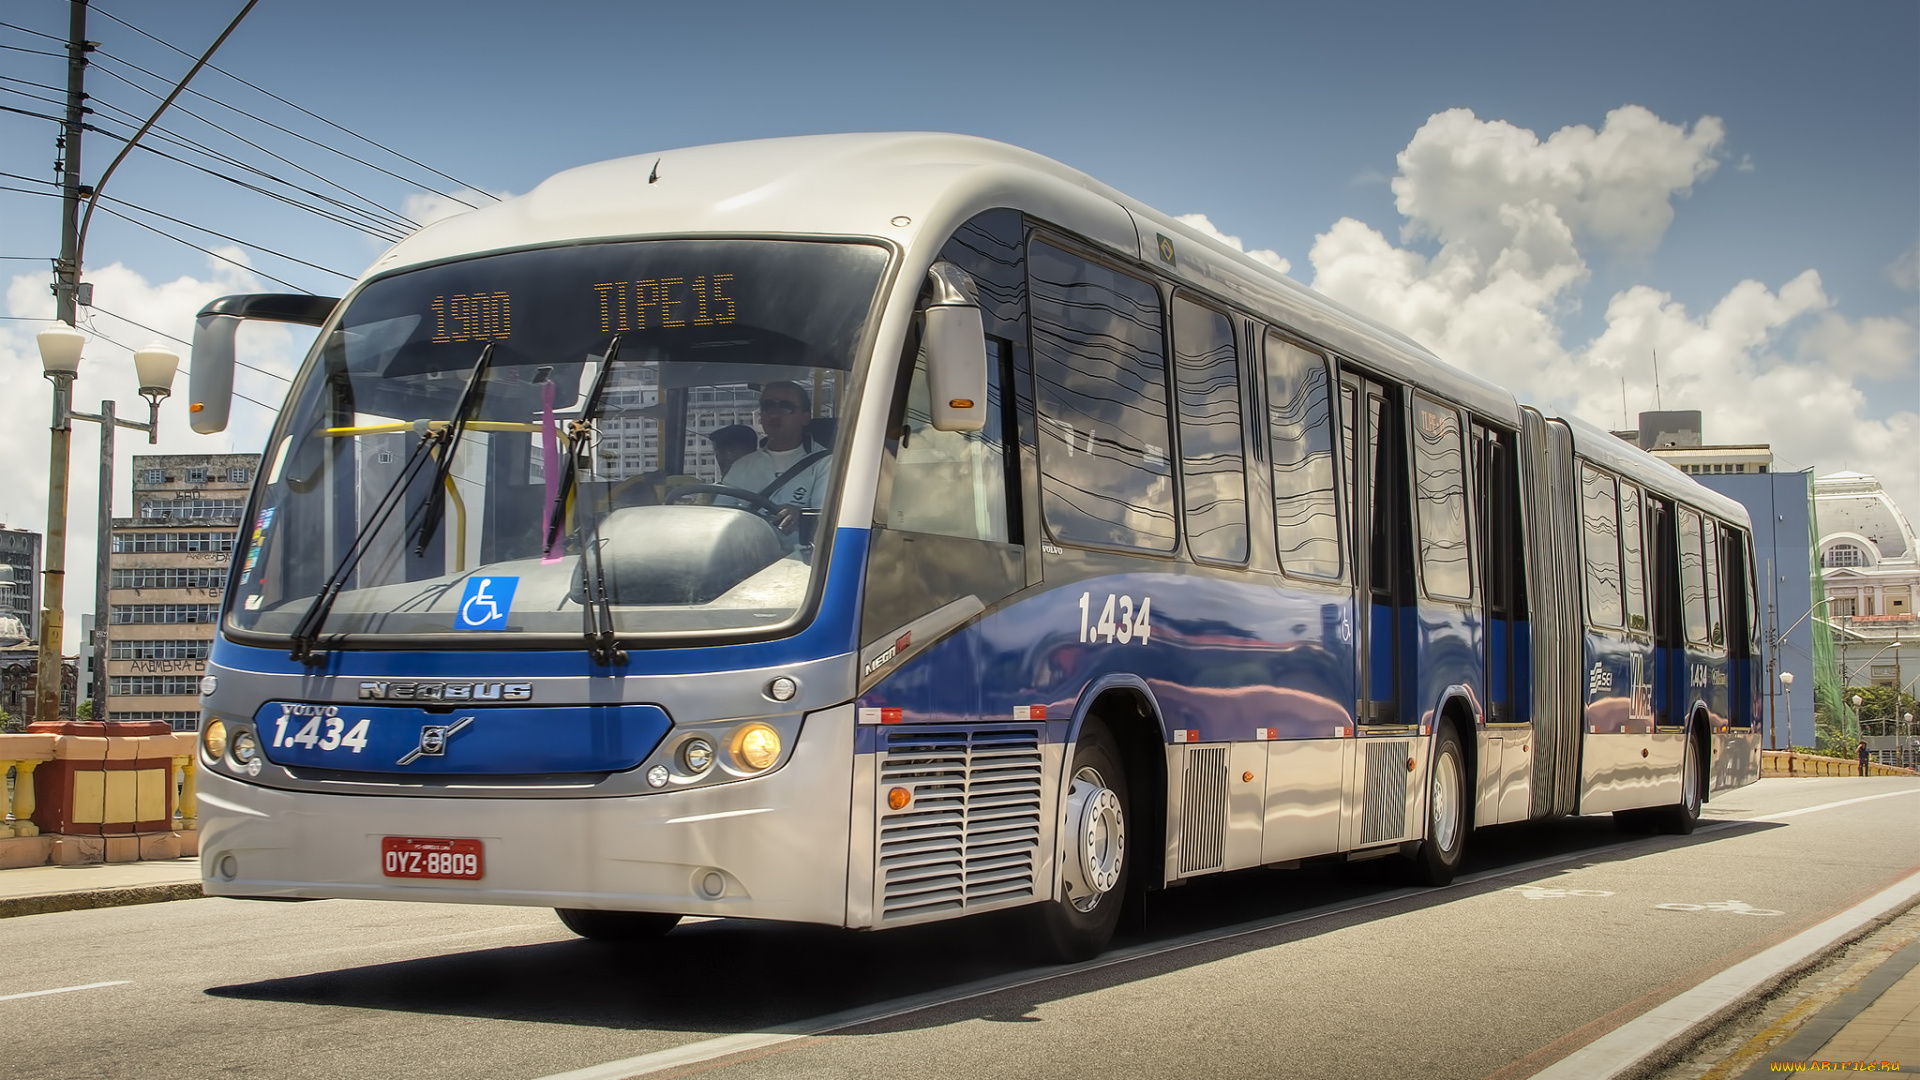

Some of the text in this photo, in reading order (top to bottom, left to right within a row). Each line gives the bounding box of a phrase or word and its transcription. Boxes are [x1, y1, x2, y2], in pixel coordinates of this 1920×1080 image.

[692, 273, 736, 327] 15
[431, 291, 511, 343] 1900
[1042, 545, 1063, 555] VOLVO
[1079, 591, 1151, 645] 1.434
[358, 681, 532, 701] NEOBUS
[280, 703, 338, 718] VOLVO
[273, 714, 371, 754] 1.434
[385, 851, 478, 875] OYZ-8809
